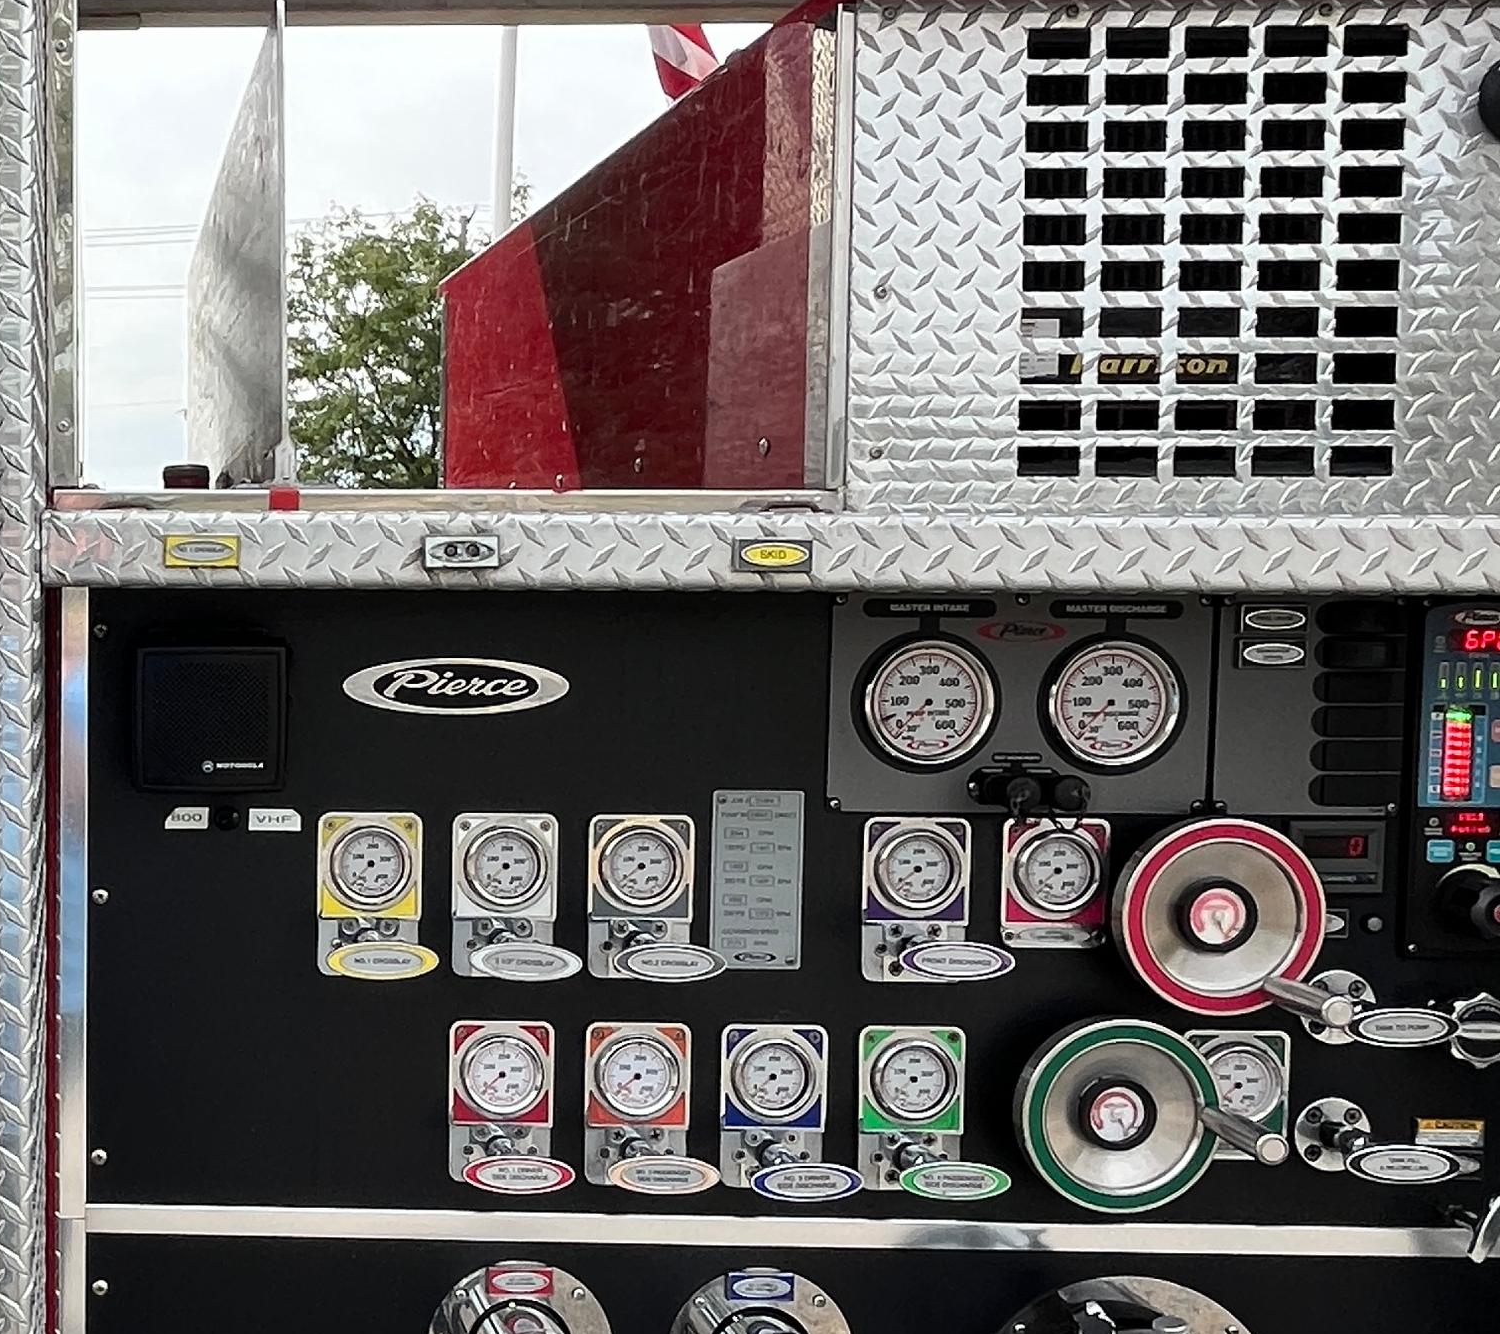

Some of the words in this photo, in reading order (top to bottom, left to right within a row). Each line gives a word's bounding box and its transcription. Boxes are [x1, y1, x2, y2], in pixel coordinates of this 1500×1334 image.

[760, 549, 787, 560] SKID
[890, 603, 931, 612] MASTER
[933, 603, 970, 612] INTAKE
[1066, 604, 1107, 613] MASTER
[1109, 605, 1168, 614] DISCHARGE
[919, 666, 940, 675] 300
[1102, 666, 1124, 676] 300
[382, 668, 531, 699] Pierce
[899, 676, 920, 685] 200
[939, 678, 960, 687] 400
[1081, 676, 1102, 686] 200
[1122, 678, 1144, 688] 400
[890, 696, 910, 706] 100
[945, 699, 966, 708] 500
[1072, 697, 1092, 706] 100
[1128, 699, 1149, 709] 500
[934, 720, 956, 730] 600
[1117, 721, 1139, 731] 600
[171, 813, 203, 822] 800
[255, 815, 293, 824] VHF
